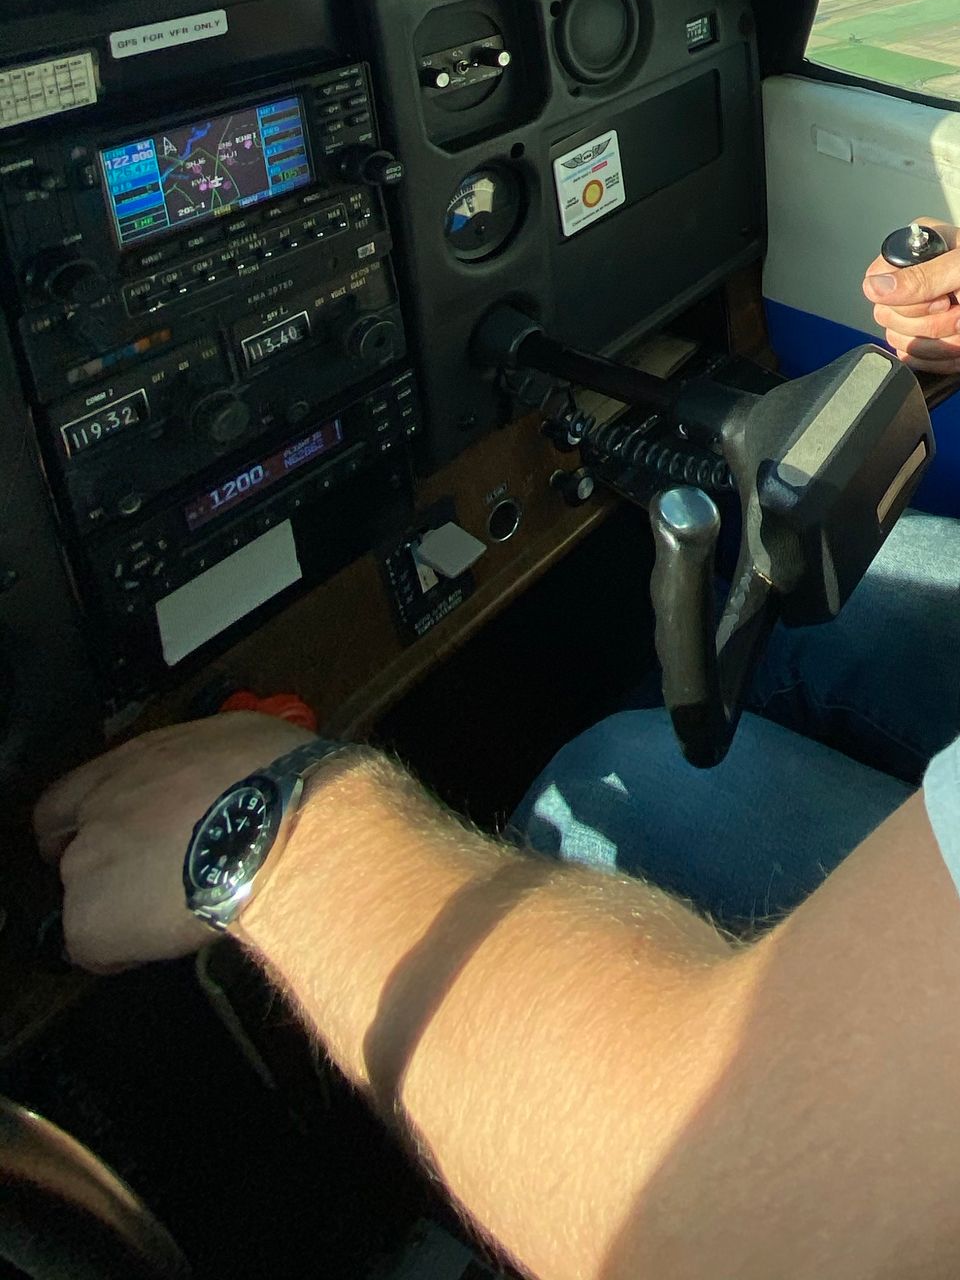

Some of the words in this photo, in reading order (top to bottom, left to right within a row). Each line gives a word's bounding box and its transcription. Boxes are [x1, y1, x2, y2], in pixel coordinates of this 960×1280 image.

[117, 38, 138, 49] GPS
[142, 32, 164, 43] FOR
[169, 26, 189, 37] VFR
[194, 20, 221, 32] ONLY
[105, 150, 154, 169] 122.800
[130, 283, 151, 297] AUTO
[209, 465, 264, 509] 1200
